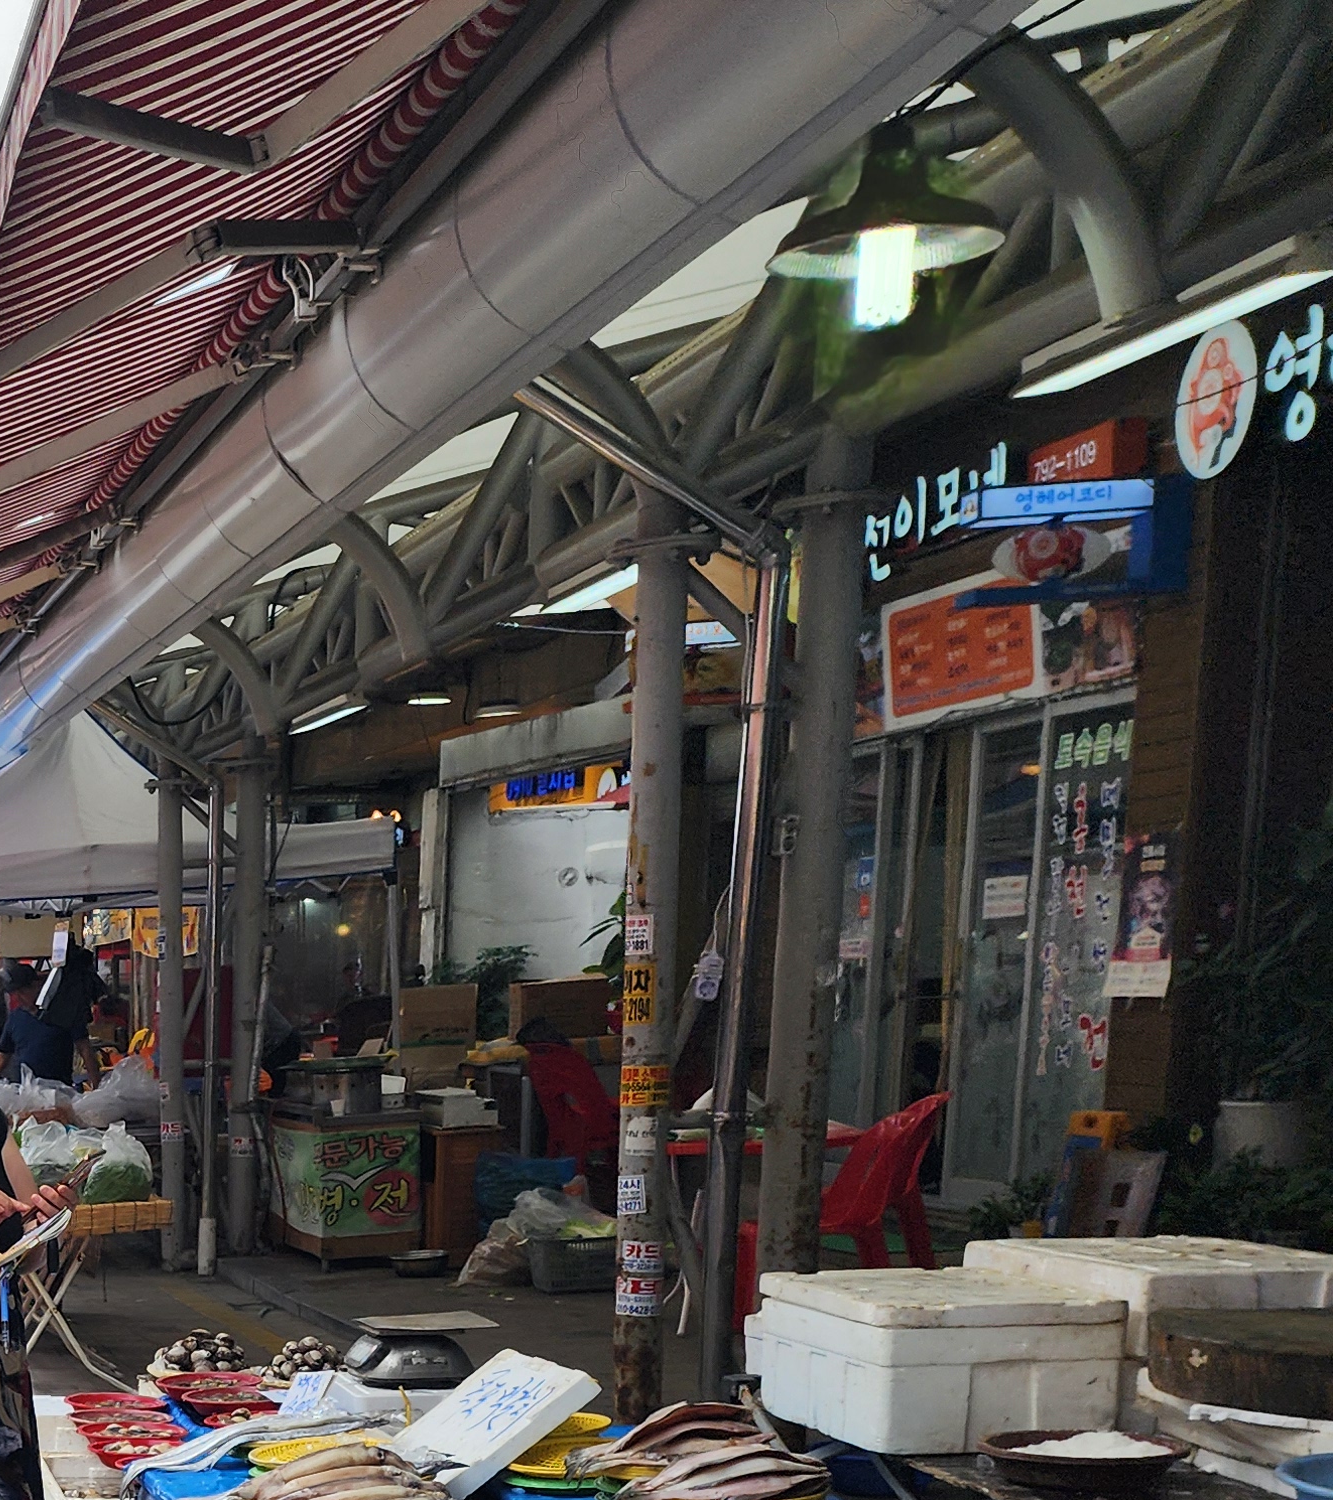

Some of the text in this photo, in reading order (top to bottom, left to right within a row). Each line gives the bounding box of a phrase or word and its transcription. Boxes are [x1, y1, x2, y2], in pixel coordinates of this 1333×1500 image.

[1265, 304, 1333, 442] 영
[1034, 440, 1097, 482] 792-1109
[626, 1244, 659, 1259] 카드
